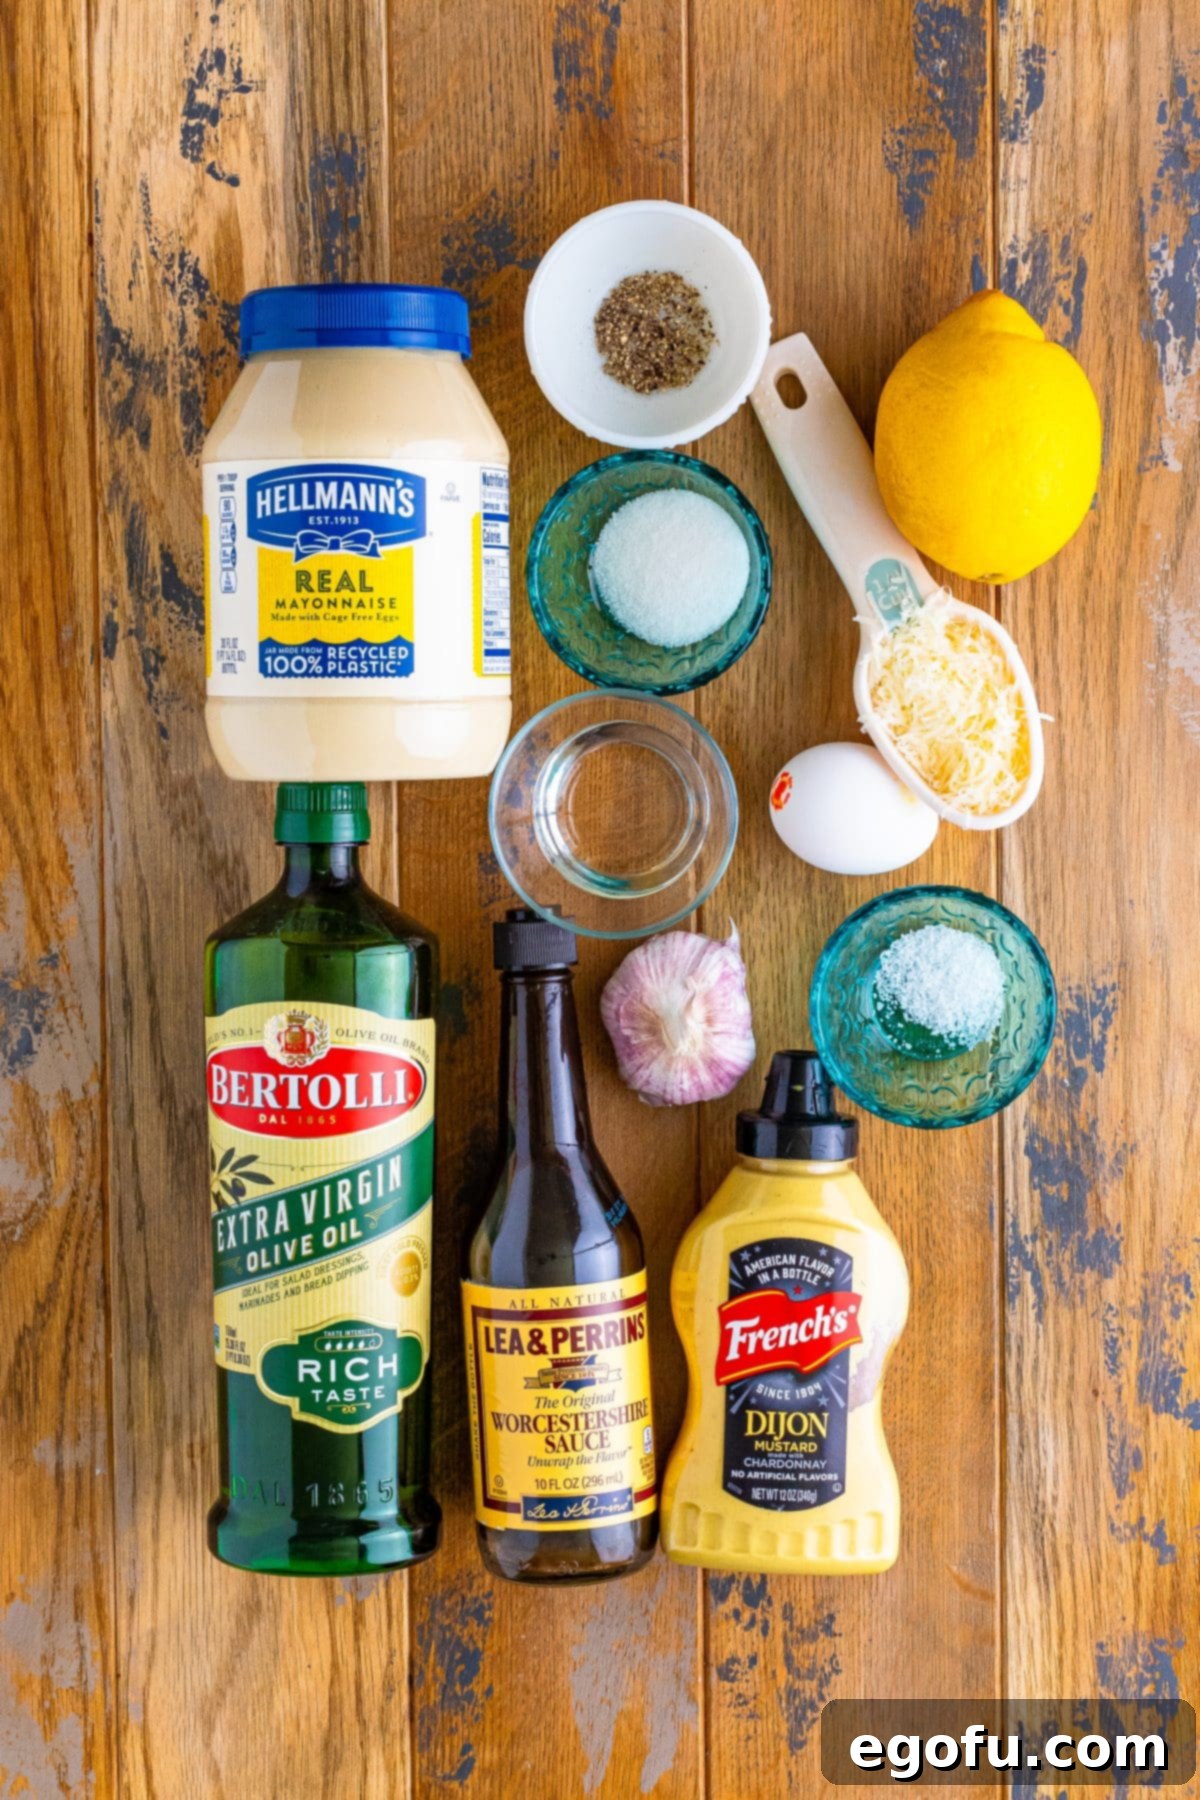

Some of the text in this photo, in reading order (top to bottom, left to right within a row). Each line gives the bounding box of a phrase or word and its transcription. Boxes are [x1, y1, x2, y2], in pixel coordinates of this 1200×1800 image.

[256, 478, 415, 519] HELLMANN'S
[308, 516, 360, 525] EST.1913
[295, 570, 374, 593] REAL
[275, 598, 398, 610] MAYONNAISE
[271, 612, 400, 624] Made with Cage Free Eggs
[264, 646, 323, 655] JAR MADE FROM
[327, 645, 409, 660] RECYCLED
[264, 656, 324, 676] 100%
[335, 1028, 431, 1064] OLIVE OIL BRAND
[211, 1063, 408, 1110] BERTOLLI
[258, 1113, 337, 1125] DAL 1865
[217, 1154, 403, 1253] EXTRA VIRGIN
[246, 1218, 364, 1274] OLIVE OIL
[744, 1254, 836, 1278] AMERICAN FLAVOR
[239, 1293, 282, 1312] MARINADES
[283, 1287, 302, 1299] AND
[304, 1277, 333, 1294] BREAD
[335, 1260, 370, 1283] DIPPING
[241, 1286, 262, 1299] IDEAL
[264, 1280, 281, 1292] FOR
[282, 1270, 312, 1287] SALAD
[757, 1267, 823, 1287] IN A BOTTLE
[509, 1288, 627, 1310] ALL NATURAL
[725, 1304, 848, 1361] French's
[298, 1353, 398, 1383] RICH
[312, 1386, 385, 1403] TASTE
[534, 1389, 616, 1410] The Original
[755, 1381, 822, 1400] SINCE 1904
[491, 1398, 649, 1434] WORCESTERSHIRE
[744, 1409, 830, 1441] DIJON
[544, 1430, 611, 1454] SAUCE
[754, 1440, 818, 1453] MUSTARD
[527, 1455, 574, 1470] Unwrap
[575, 1454, 593, 1466] the
[743, 1457, 828, 1470] CHARDONNAY
[535, 1479, 548, 1490] 10
[549, 1478, 562, 1489] FL
[563, 1477, 580, 1489] OZ
[582, 1475, 604, 1489] (296
[731, 1470, 839, 1482] NO ARTIFICIAL FLAVORS
[231, 1475, 394, 1508] DAL 1865
[751, 1487, 766, 1500] NET
[766, 1488, 779, 1501] WT
[779, 1489, 787, 1501] 12
[787, 1490, 797, 1501] OZ
